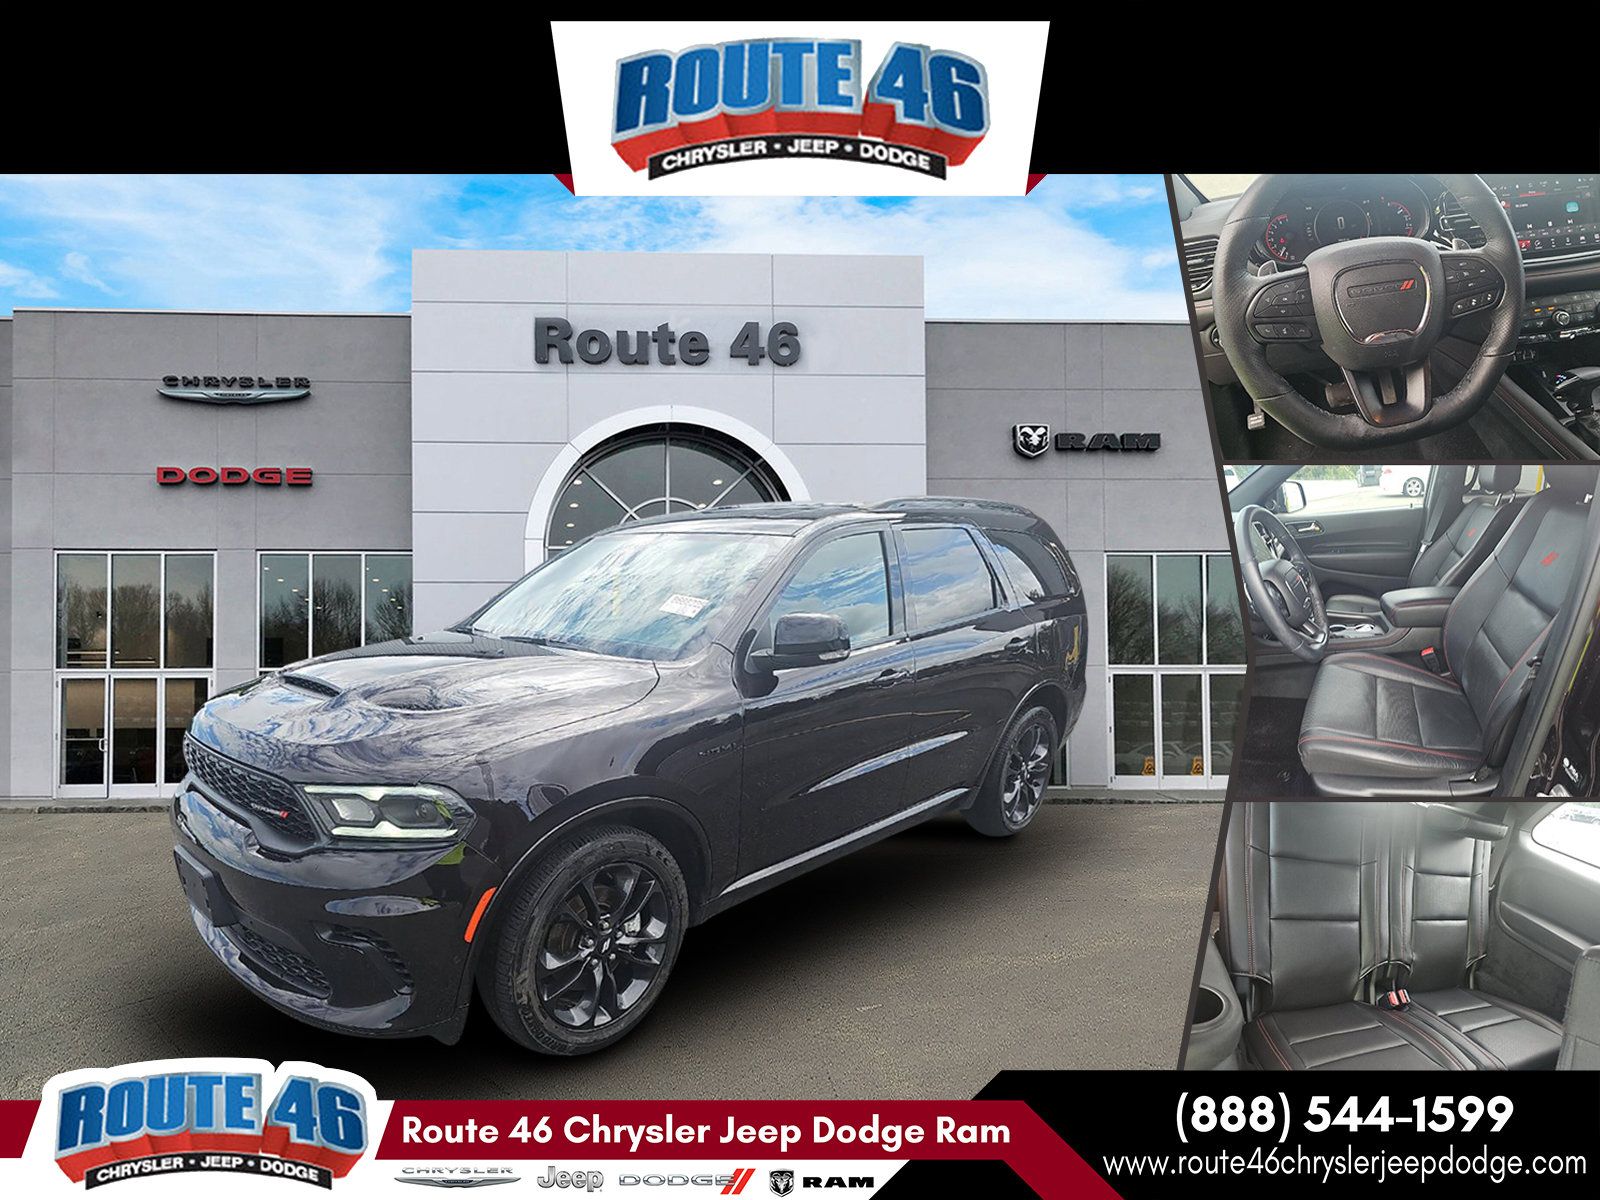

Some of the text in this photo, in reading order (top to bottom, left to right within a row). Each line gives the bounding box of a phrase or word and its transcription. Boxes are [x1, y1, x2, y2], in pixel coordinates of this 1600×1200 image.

[534, 317, 801, 367] Route 46
[162, 375, 311, 388] CHRYSLER
[1055, 432, 1161, 452] RAM
[156, 466, 313, 486] DODGE
